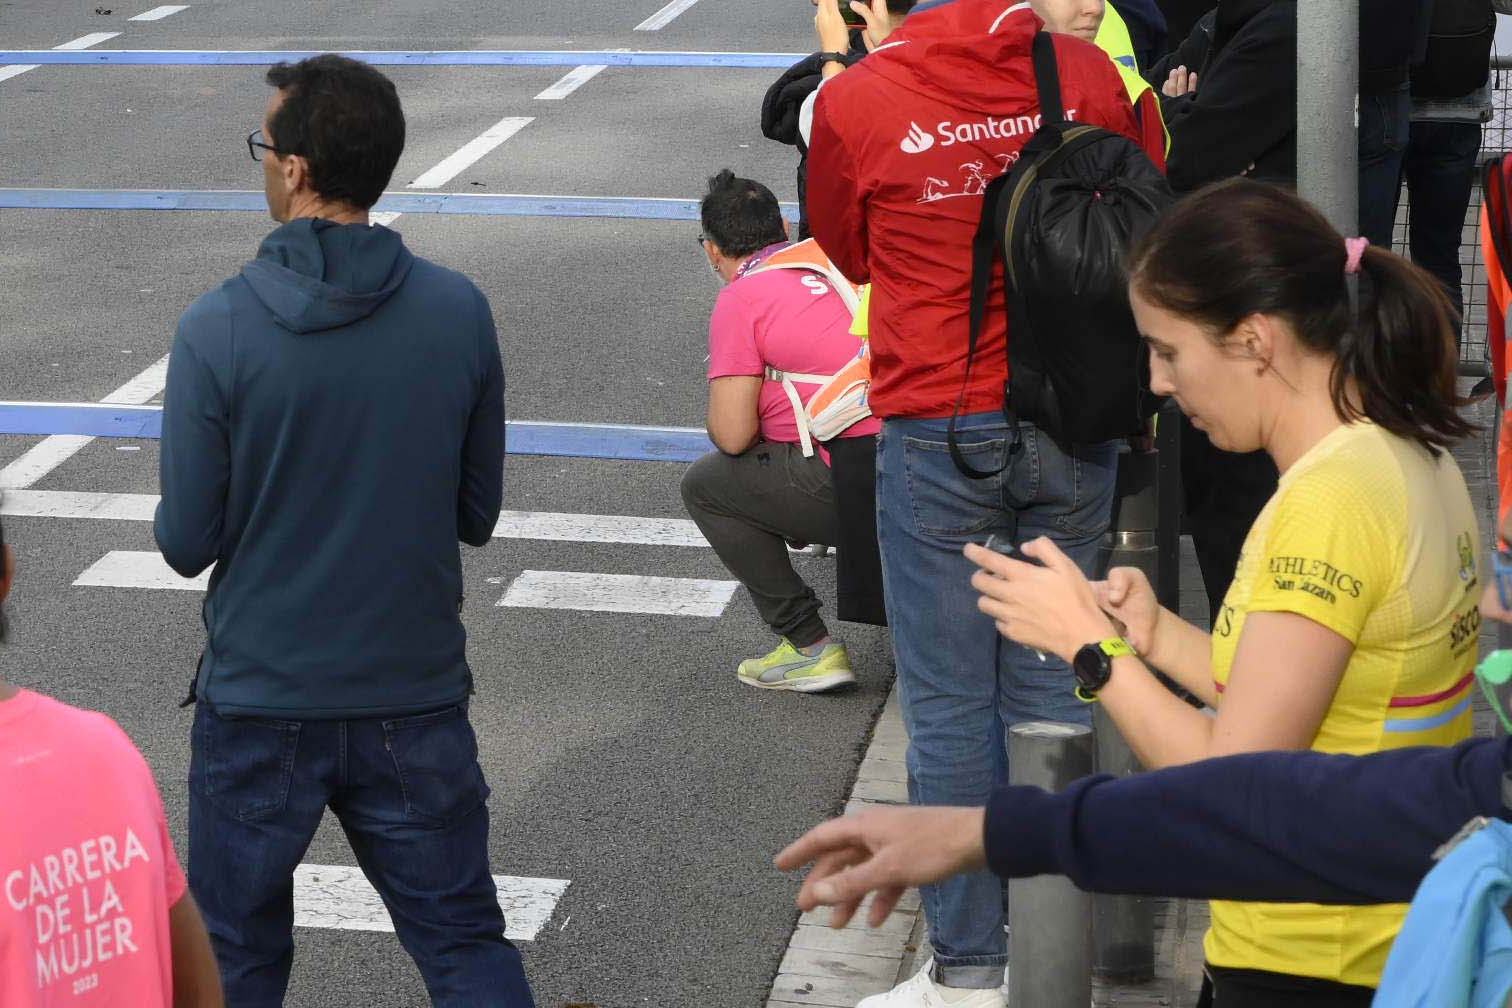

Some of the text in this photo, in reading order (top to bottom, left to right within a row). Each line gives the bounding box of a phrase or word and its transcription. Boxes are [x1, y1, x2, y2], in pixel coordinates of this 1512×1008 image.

[937, 109, 1076, 146] Santanr
[5, 826, 150, 912] CARRERA
[35, 878, 124, 944] DE LA
[35, 918, 139, 990] MUJER
